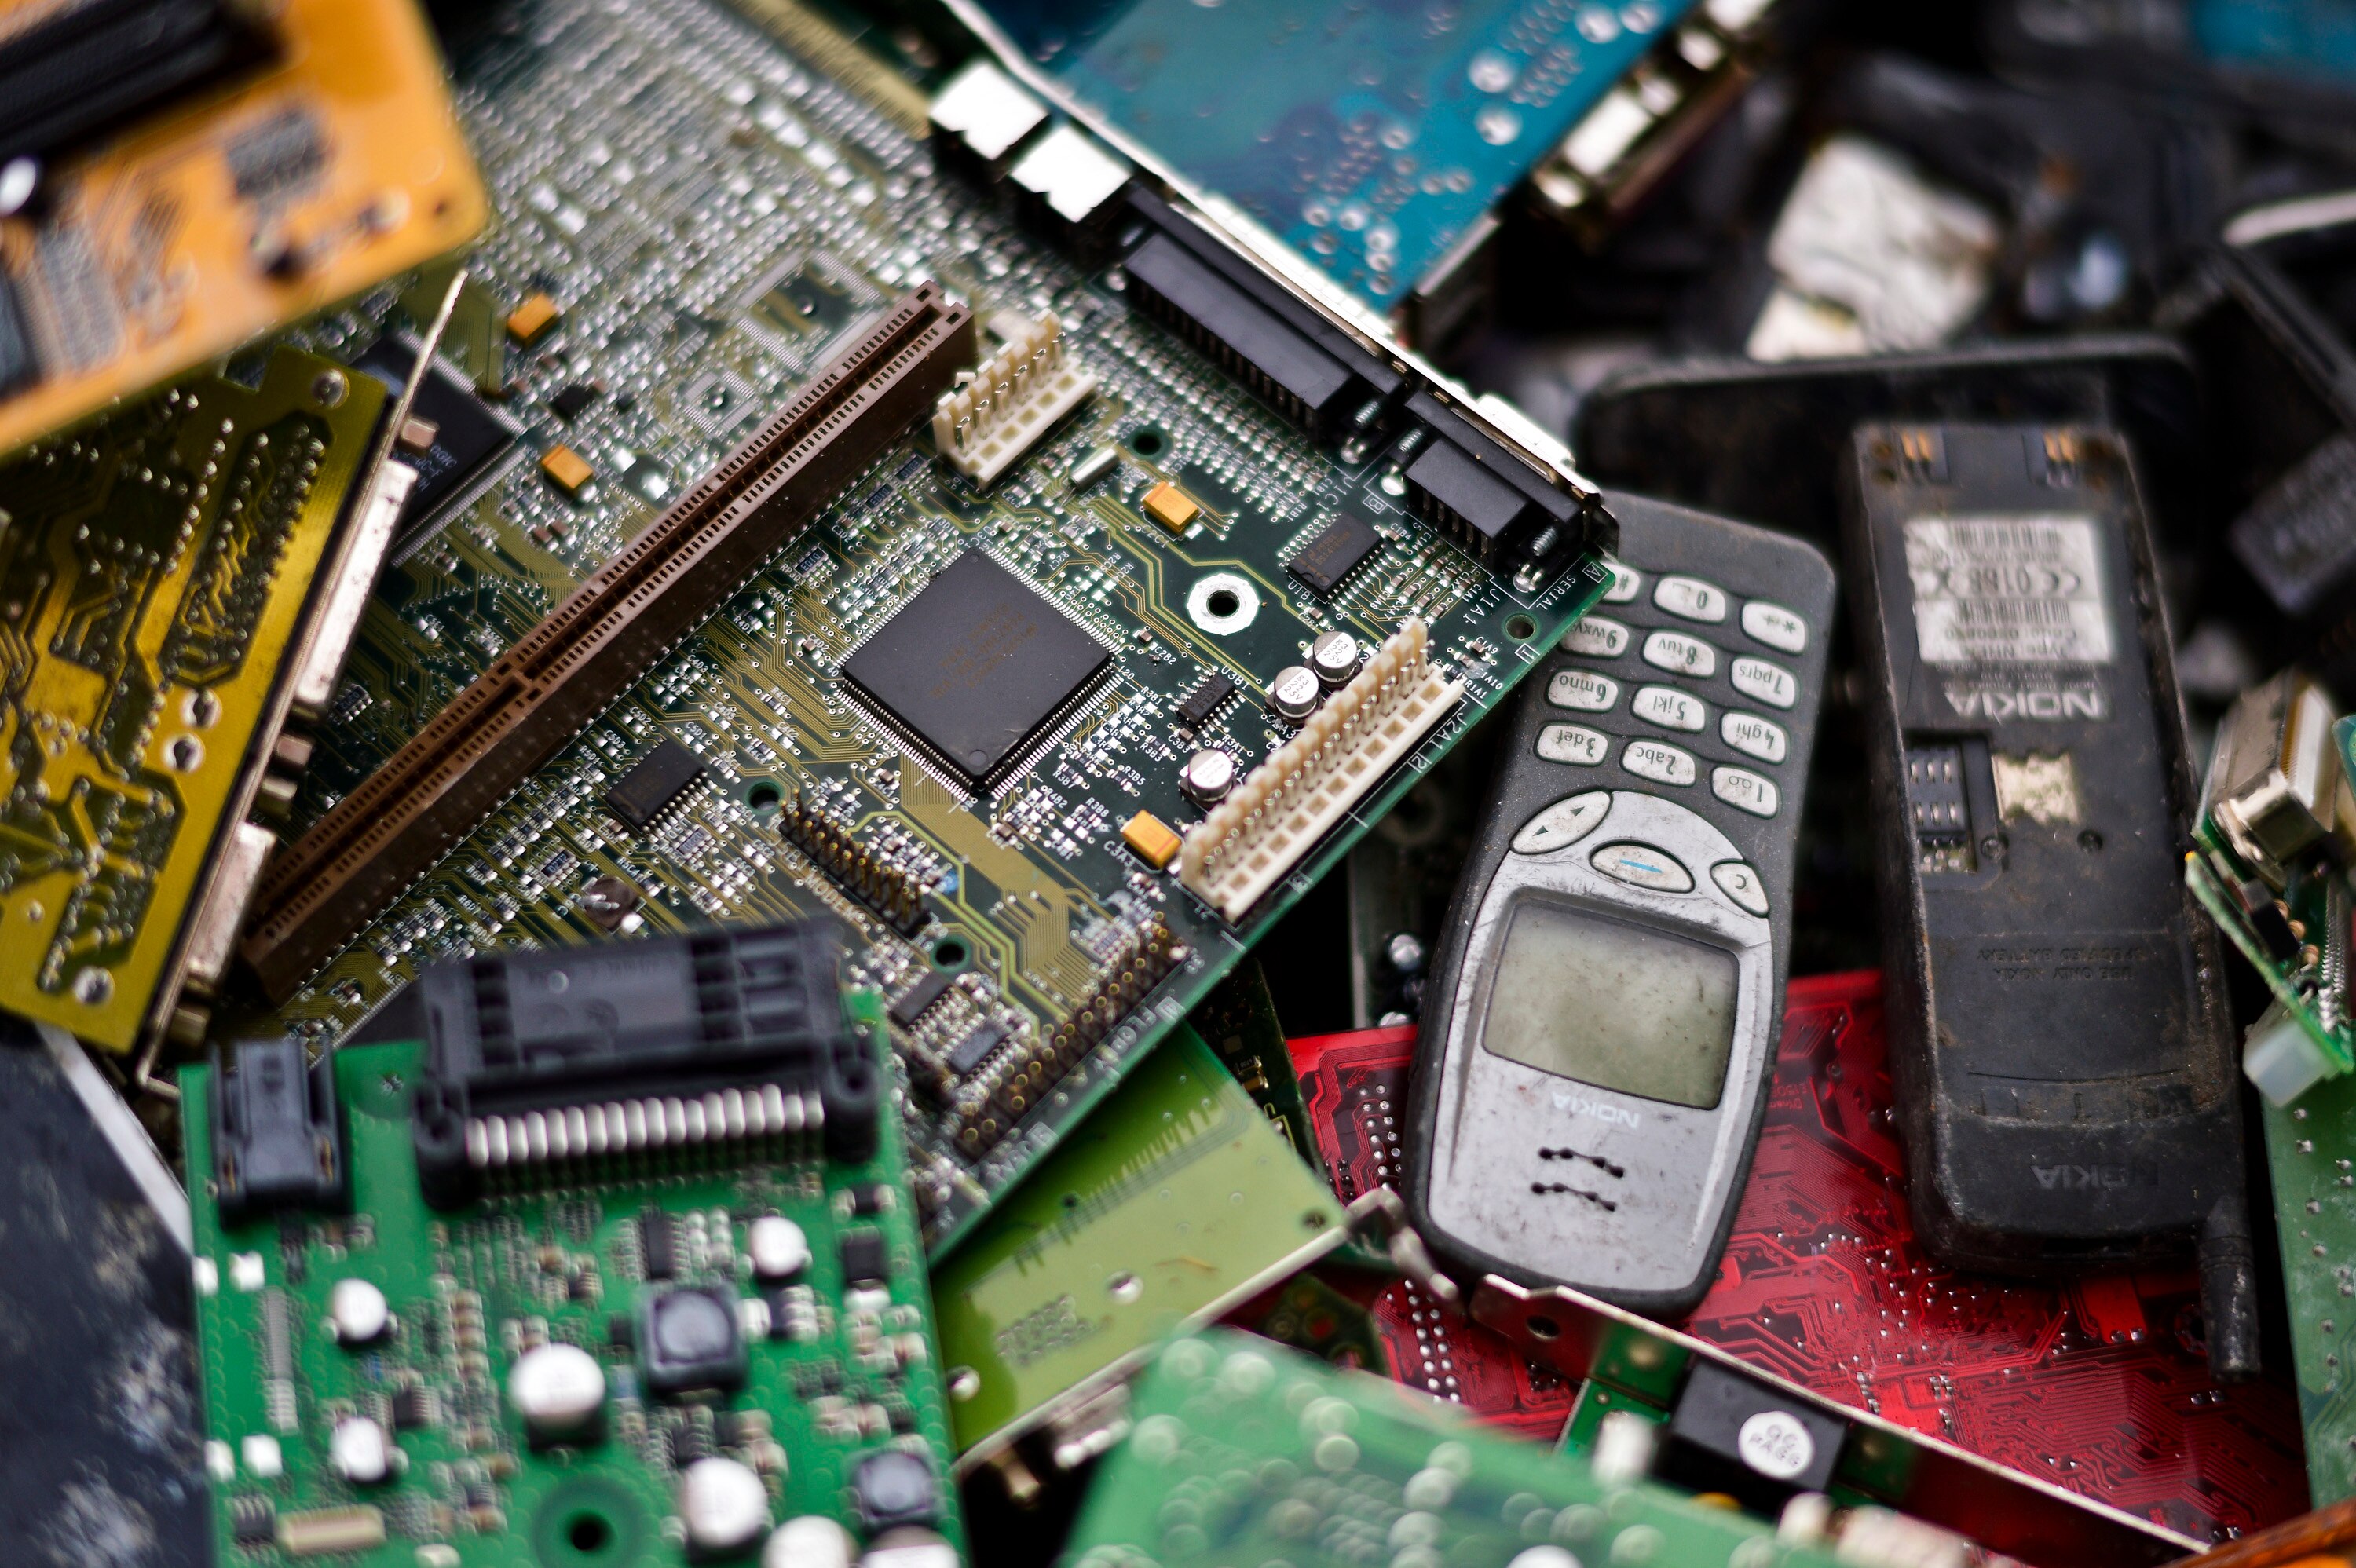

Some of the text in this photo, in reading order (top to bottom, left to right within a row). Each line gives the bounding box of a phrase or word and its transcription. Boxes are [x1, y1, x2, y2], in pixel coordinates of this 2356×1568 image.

[1312, 477, 1333, 497] C1B1
[1314, 474, 1357, 514] J1C1
[1285, 501, 1308, 522] R1B1
[1368, 496, 1383, 512] B
[933, 514, 955, 534] R3D1
[1085, 511, 1109, 532] R2C2
[1388, 519, 1412, 544] C1B4
[830, 524, 852, 543] C3D2
[964, 521, 992, 553] U3C1
[1141, 521, 1169, 550] C2C1
[1408, 530, 1432, 553] C1A4
[1048, 549, 1070, 572] R2C7
[1099, 550, 1121, 573] R2C5
[779, 563, 806, 586] RP3D3
[1112, 560, 1134, 583] R2C4
[1586, 565, 1603, 579] A
[766, 587, 788, 605] C4D1
[1286, 576, 1317, 609] U1B1
[1459, 581, 1483, 604] C1A1
[1535, 576, 1576, 611] SERIAL
[1381, 599, 1405, 620] C1A7
[1459, 586, 1504, 627] J1A1
[732, 616, 753, 634] R4D1
[1297, 609, 1318, 634] C2B1
[806, 632, 829, 652] C4D2
[1329, 642, 1342, 656] 22
[1476, 636, 1498, 655] C1A9
[686, 652, 709, 674] C4D3
[1153, 645, 1176, 666] C2B2
[1323, 647, 1342, 668] 25V
[1117, 664, 1135, 681] 120
[1219, 663, 1251, 692] U3B1
[770, 685, 792, 706] R4C1
[1140, 685, 1163, 705] R3B1
[1283, 683, 1302, 704] 25V
[1290, 678, 1303, 693] 22
[1463, 678, 1488, 700] R1A1
[1944, 691, 2098, 716] NOKIA
[627, 705, 651, 726] C5D2
[602, 728, 627, 749] C5D3
[684, 719, 708, 740] C5D1
[1436, 711, 1469, 752] J2A1
[1139, 740, 1164, 763] R3B3
[1166, 733, 1191, 755] C3B3
[1221, 733, 1246, 754] R3A1
[577, 744, 601, 765] R5D1
[1052, 769, 1076, 790] R3B7
[1121, 765, 1146, 786] R3B5
[1044, 788, 1068, 810] R4B2
[1085, 796, 1110, 817] R3B8
[508, 824, 533, 847] R6D2
[573, 832, 597, 854] R5D3
[751, 838, 776, 860] C5C2
[1103, 839, 1137, 868] C3A3
[1734, 873, 1747, 890] C
[801, 872, 860, 923] MODEM
[394, 920, 418, 942] R7D1
[1975, 947, 2052, 963] BATTERY
[2052, 966, 2093, 981] ONLY
[328, 986, 352, 1008] C7D1
[1552, 1092, 1640, 1129] NOKIA
